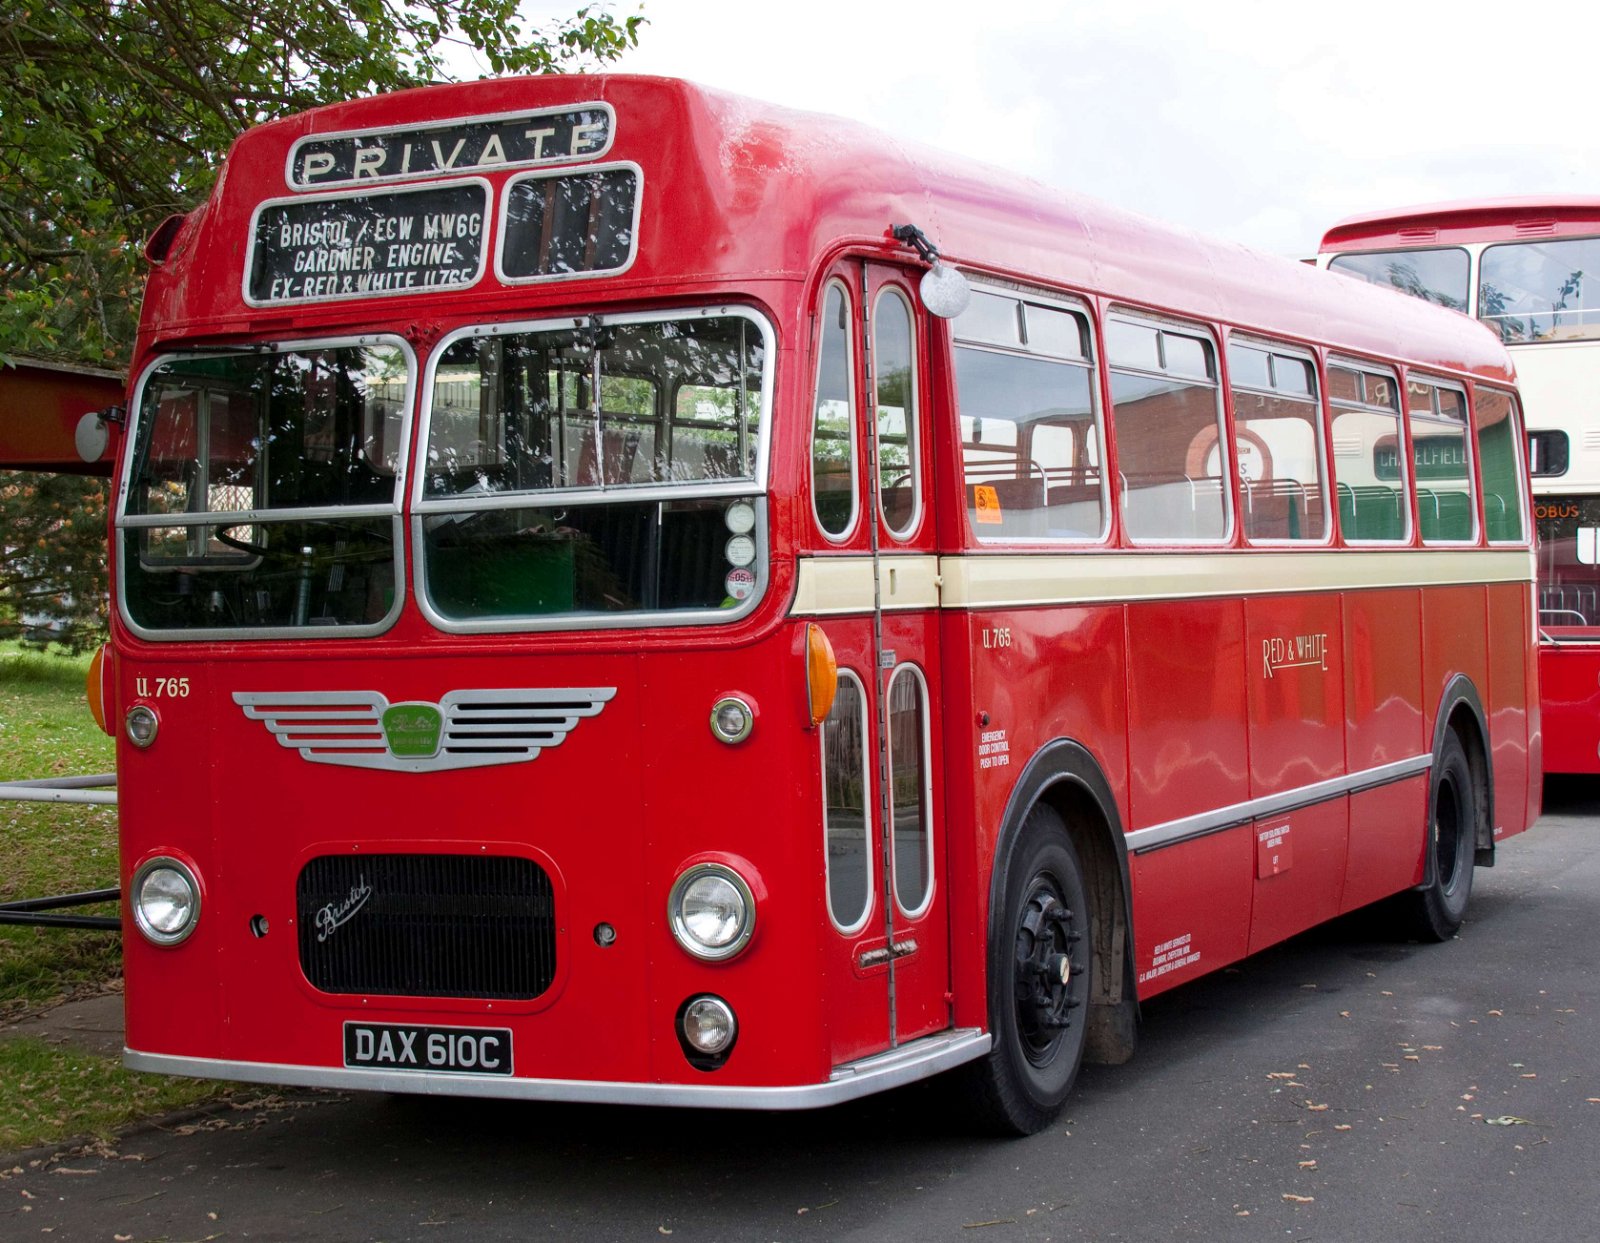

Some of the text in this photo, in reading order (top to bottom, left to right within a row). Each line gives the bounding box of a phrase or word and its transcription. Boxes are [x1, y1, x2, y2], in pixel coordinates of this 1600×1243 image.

[303, 122, 602, 184] PRIVATE
[280, 220, 348, 247] BRISTOL
[374, 216, 414, 241] ECW
[423, 213, 481, 239] MW6G
[294, 243, 457, 272] GARDNER ENGINE
[341, 275, 353, 294] &
[357, 271, 417, 293] WHITE
[1263, 634, 1329, 679] RED & WHITE
[315, 873, 371, 942] Bristol
[355, 1029, 500, 1068] DAX 610C
